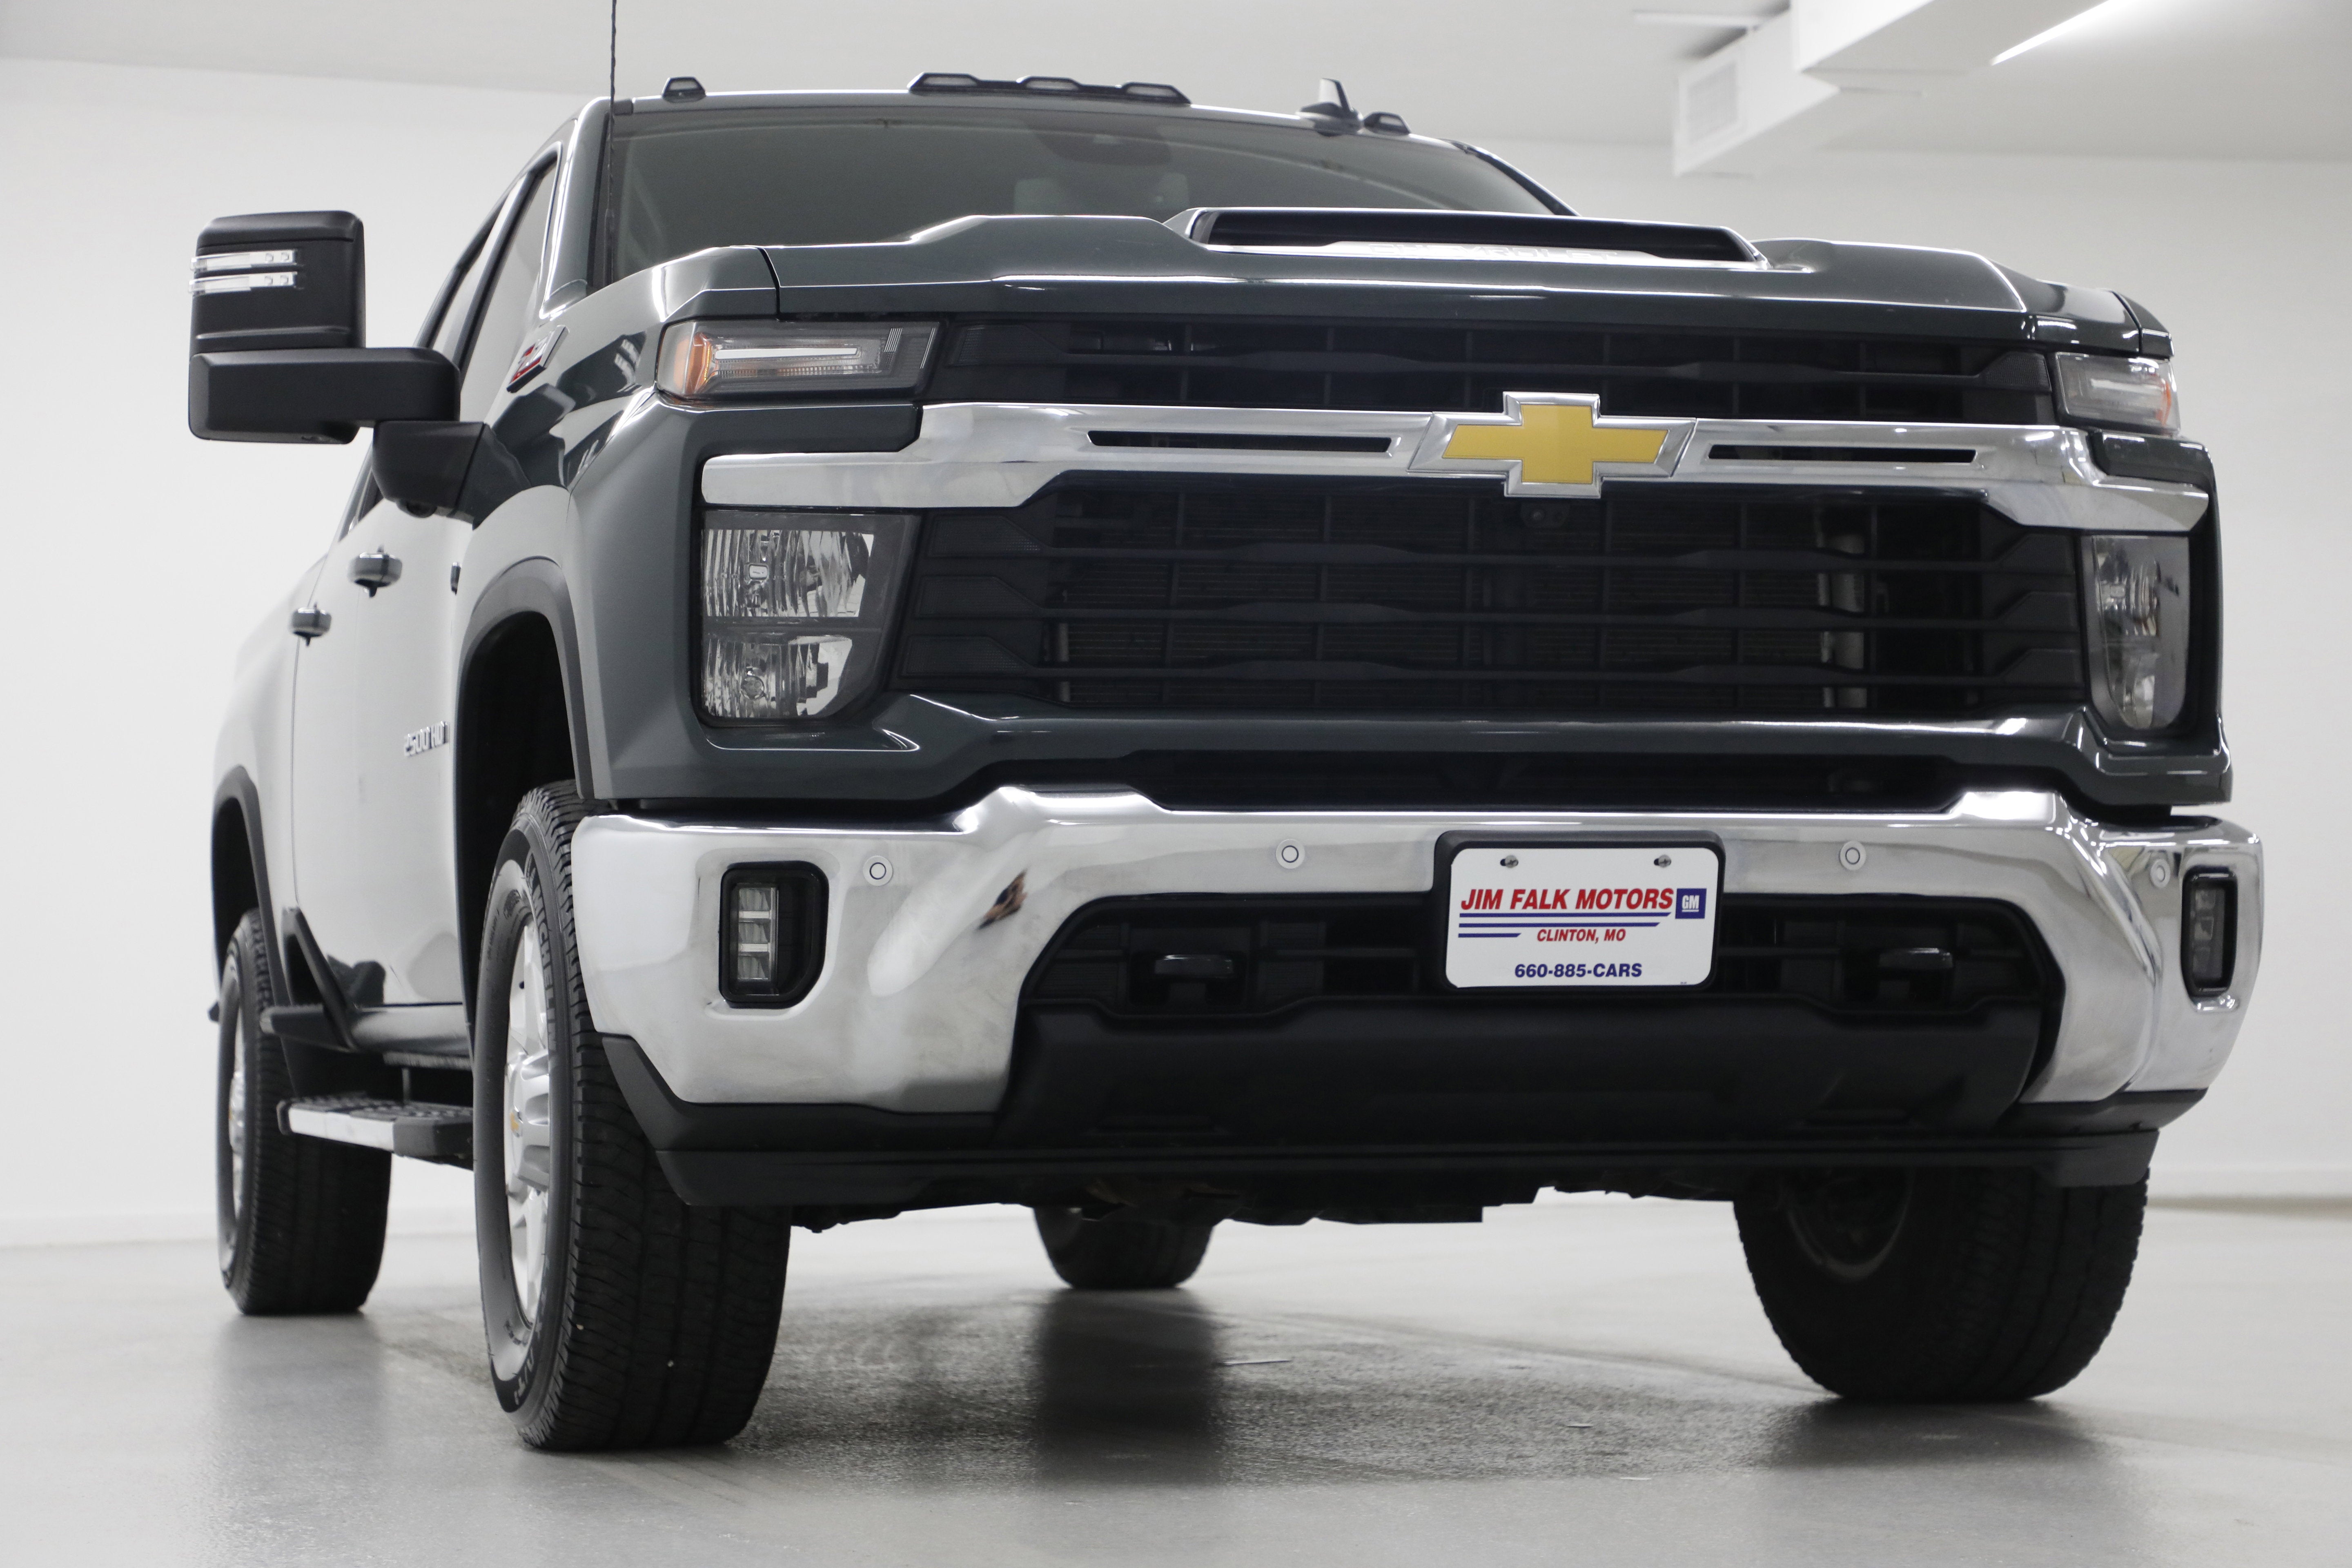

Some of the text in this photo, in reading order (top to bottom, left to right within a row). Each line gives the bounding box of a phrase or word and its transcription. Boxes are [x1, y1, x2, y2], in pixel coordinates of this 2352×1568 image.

[1461, 888, 1674, 910] JIM FALK MOTORS
[1682, 895, 1699, 909] GM
[1537, 929, 1626, 944] CLINTON, MO
[532, 884, 556, 1051] MICHELIN
[1515, 963, 1642, 978] 660-885-CARS
